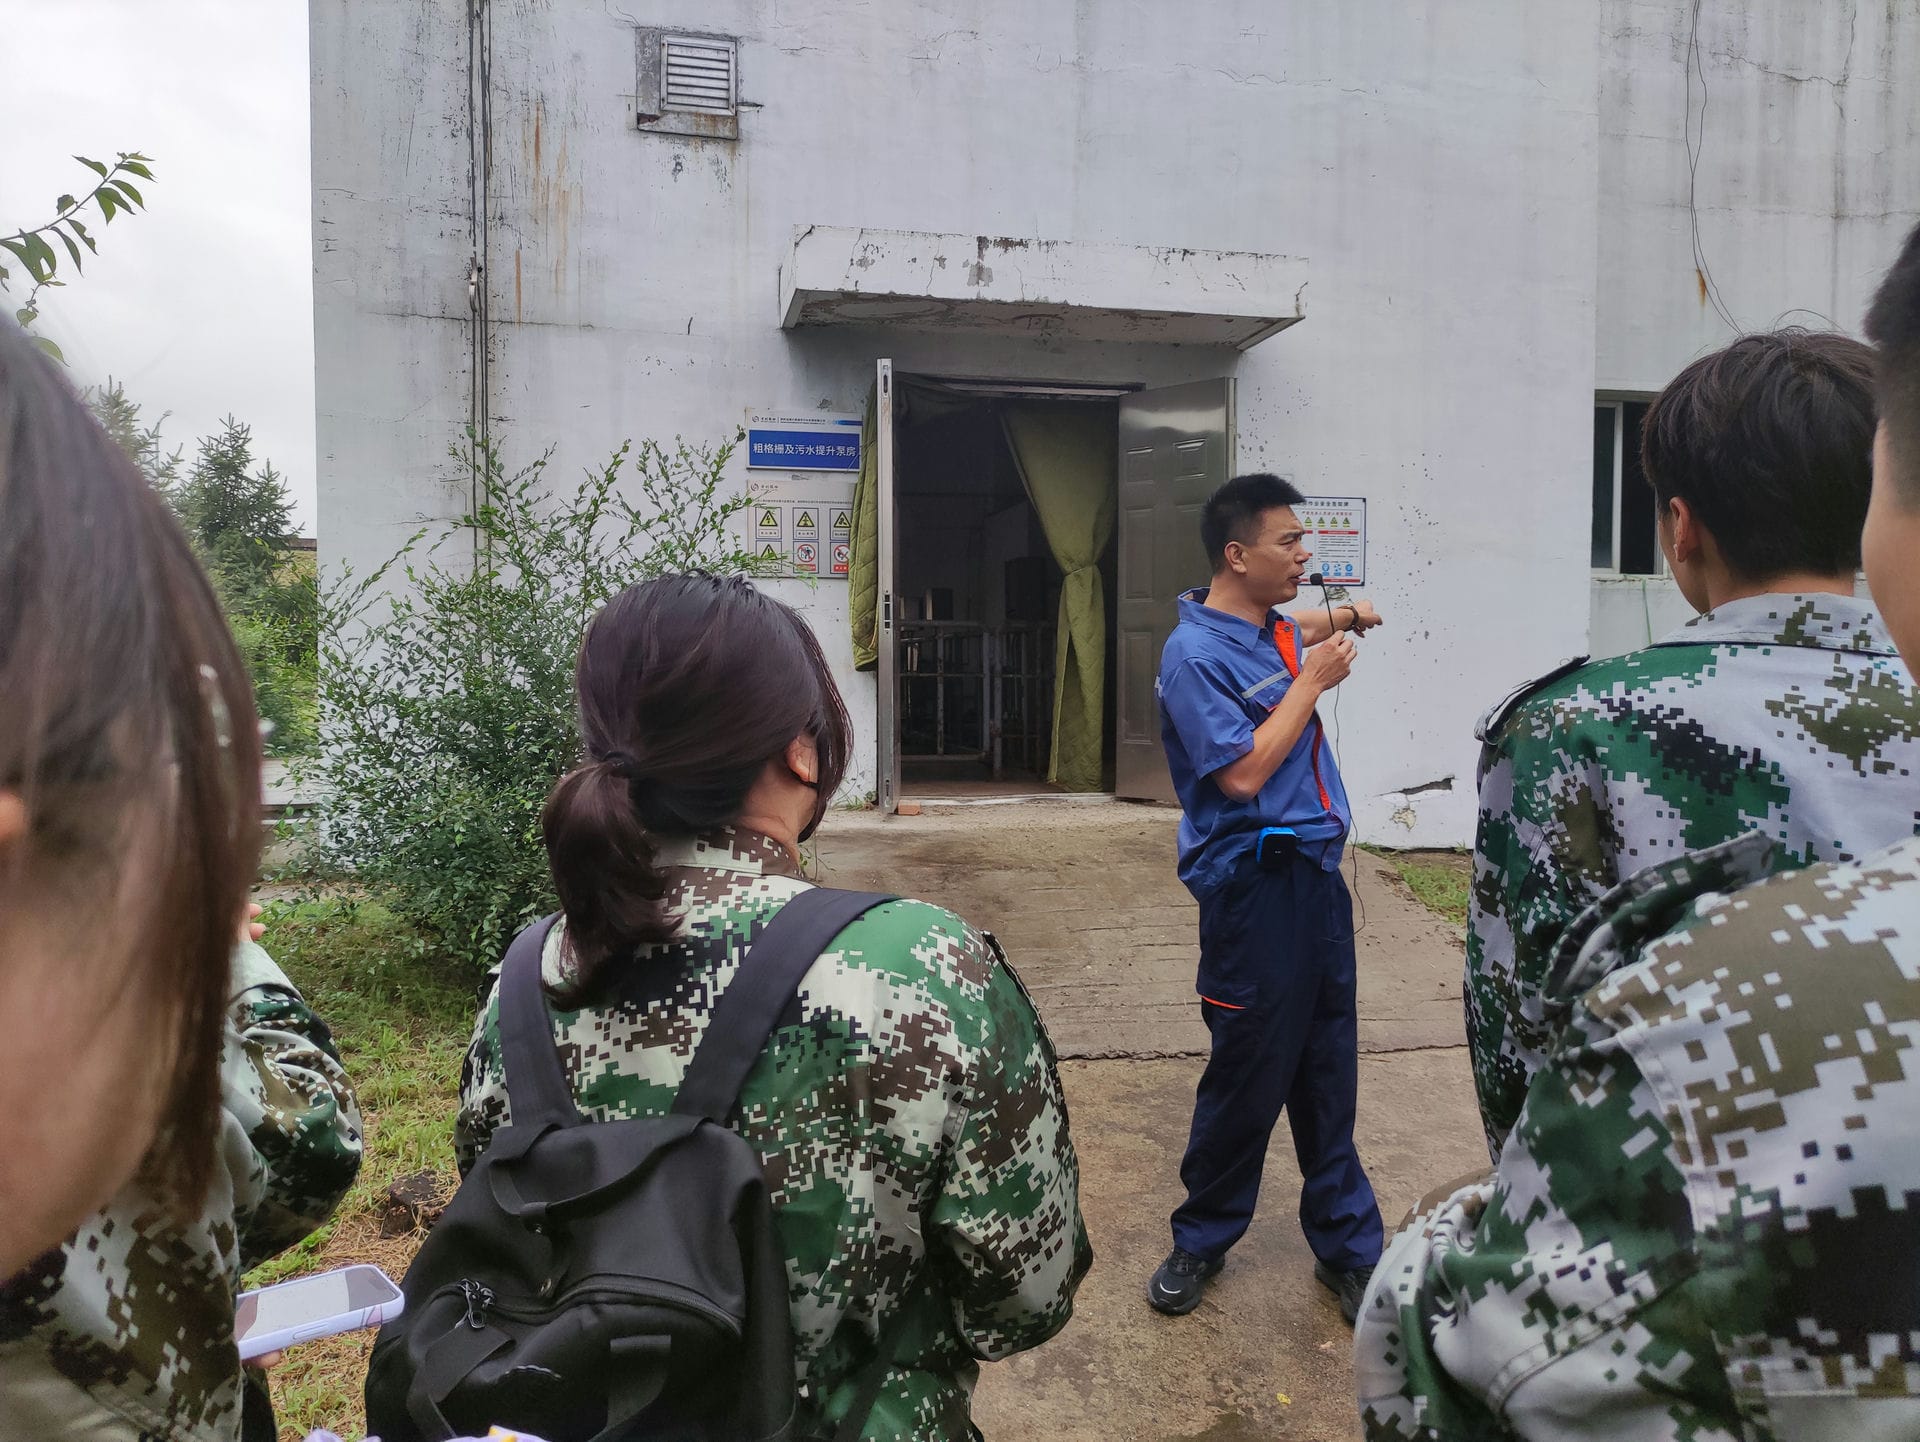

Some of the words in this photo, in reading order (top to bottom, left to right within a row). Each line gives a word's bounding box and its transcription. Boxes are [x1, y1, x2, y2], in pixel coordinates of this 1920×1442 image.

[753, 442, 857, 457] 粗格栅及污水提升泵房
